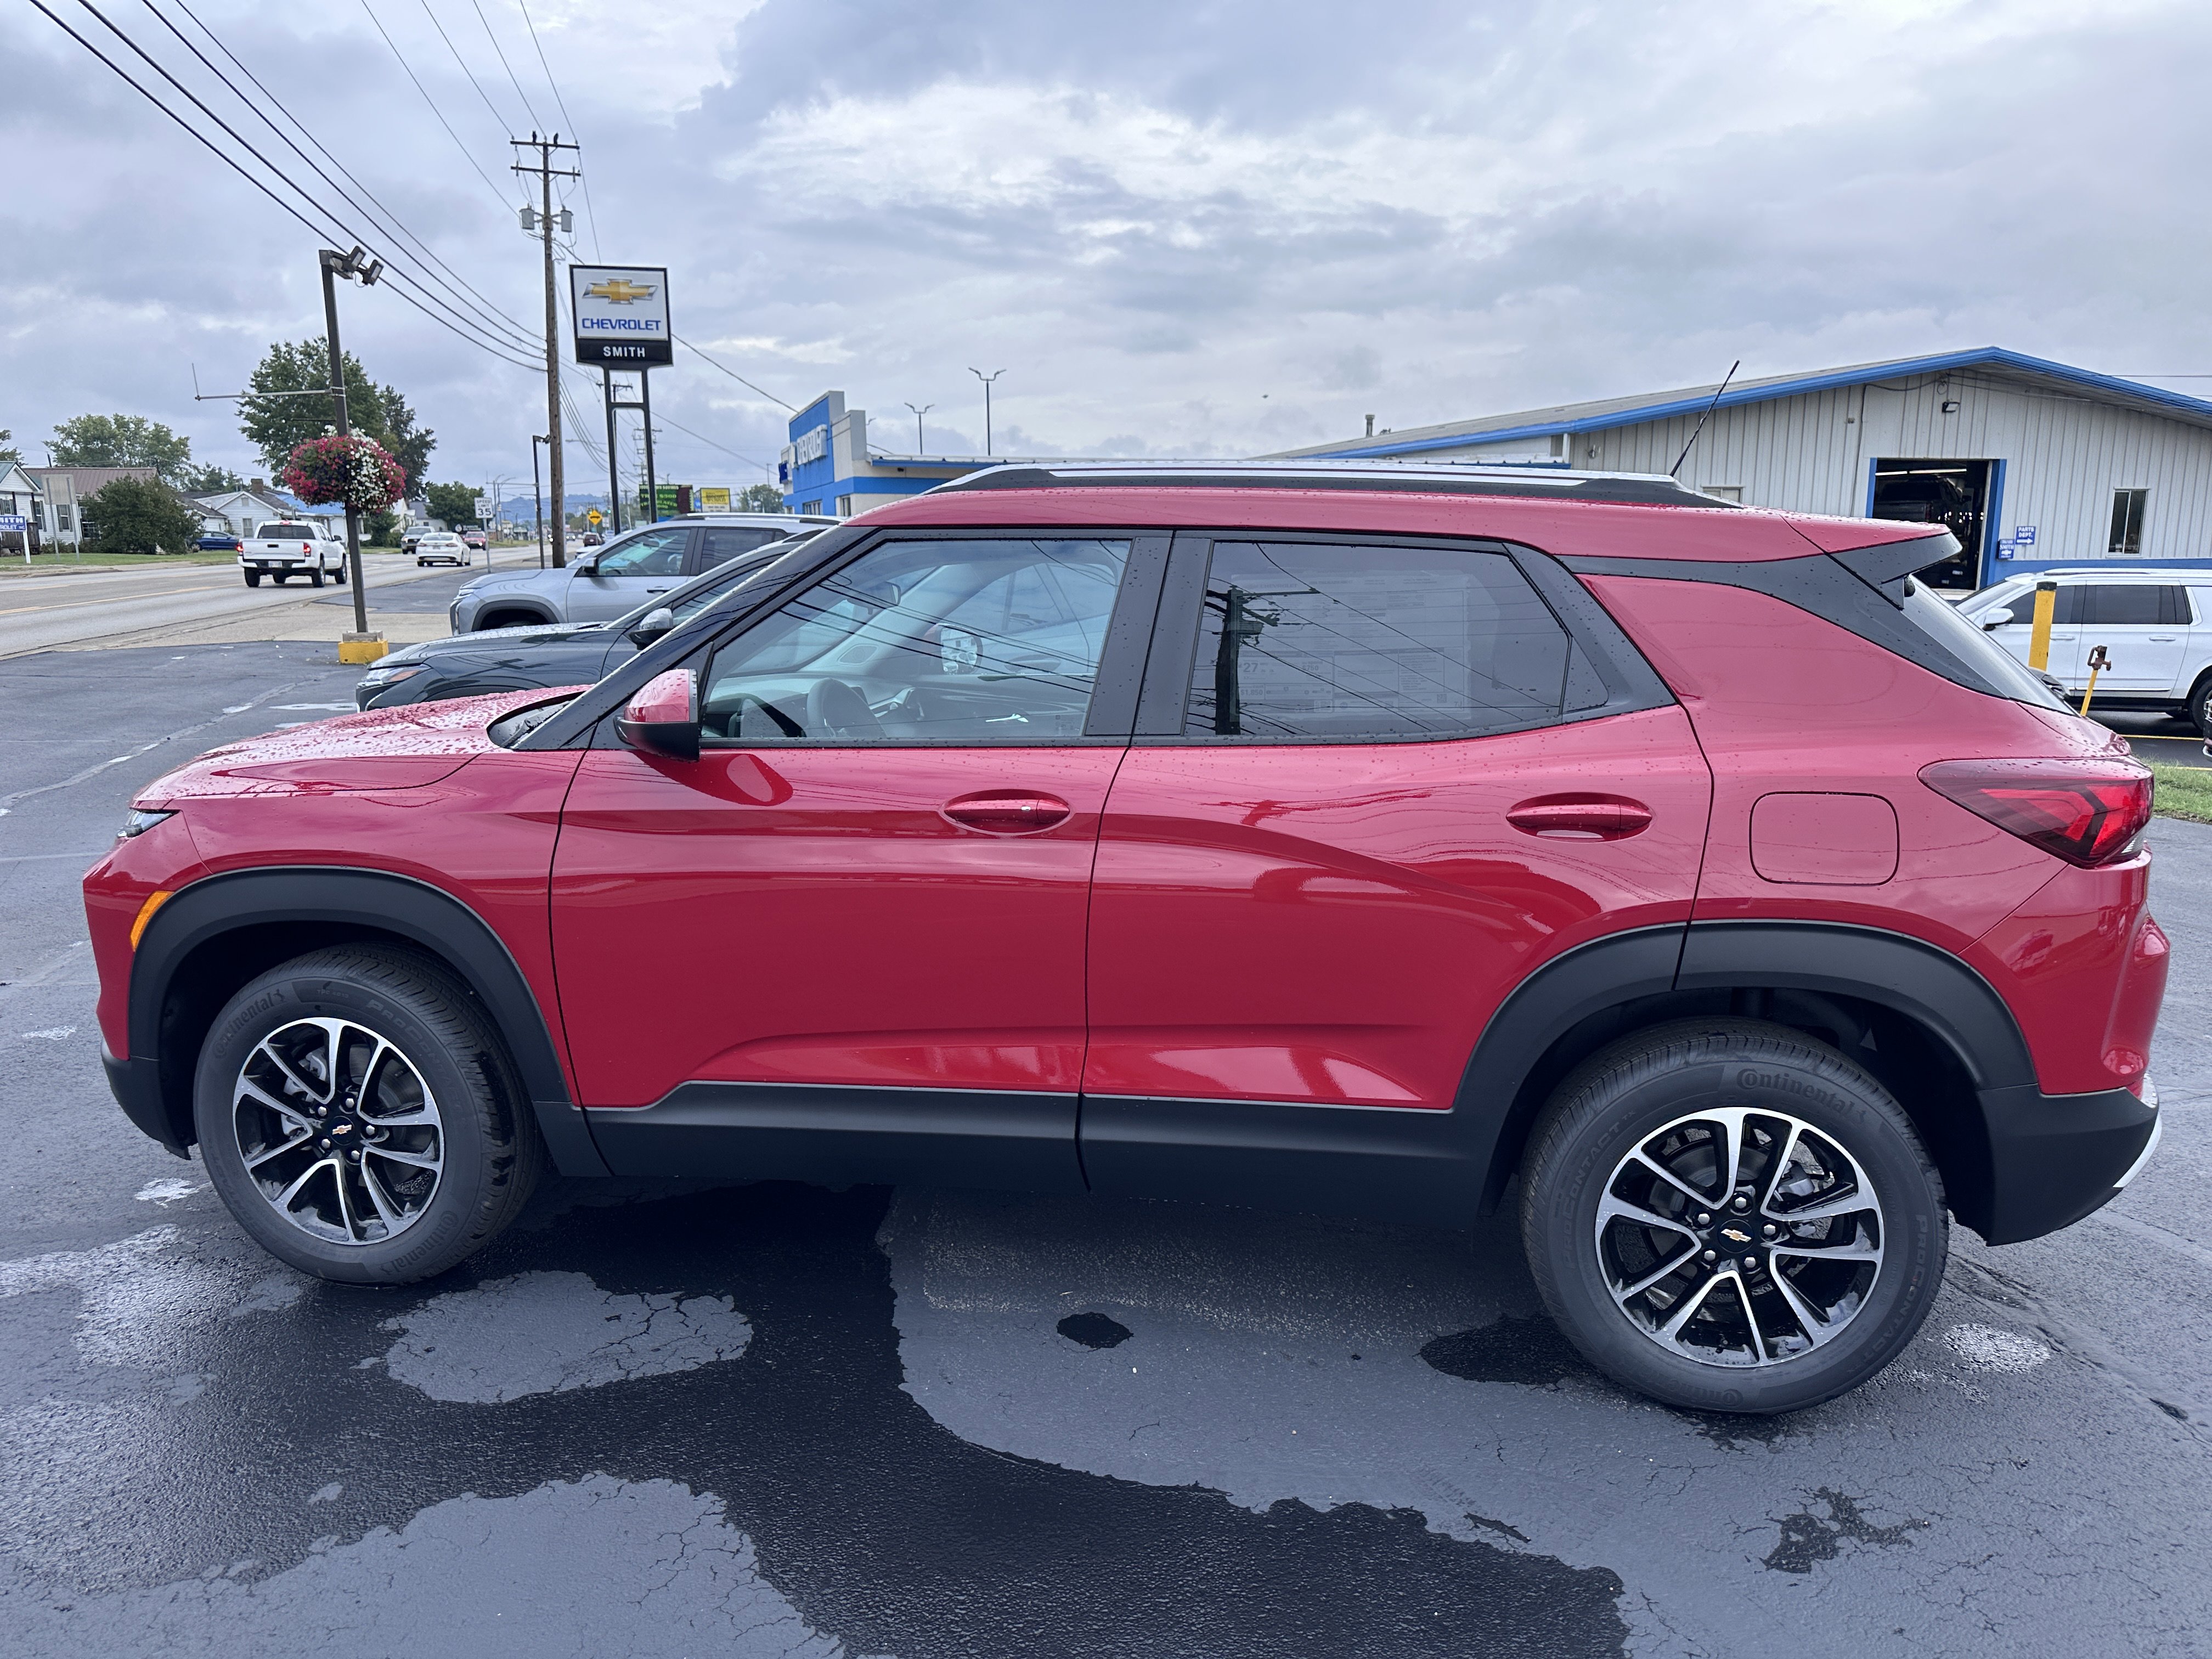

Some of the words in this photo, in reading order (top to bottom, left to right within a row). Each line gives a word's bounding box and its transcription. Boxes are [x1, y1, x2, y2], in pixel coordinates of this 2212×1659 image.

[582, 318, 661, 330] CHEVROLET
[603, 346, 645, 357] SMITH
[1243, 662, 1258, 673] 27
[1737, 1069, 1855, 1115] Continental
[388, 1210, 459, 1273] Continental
